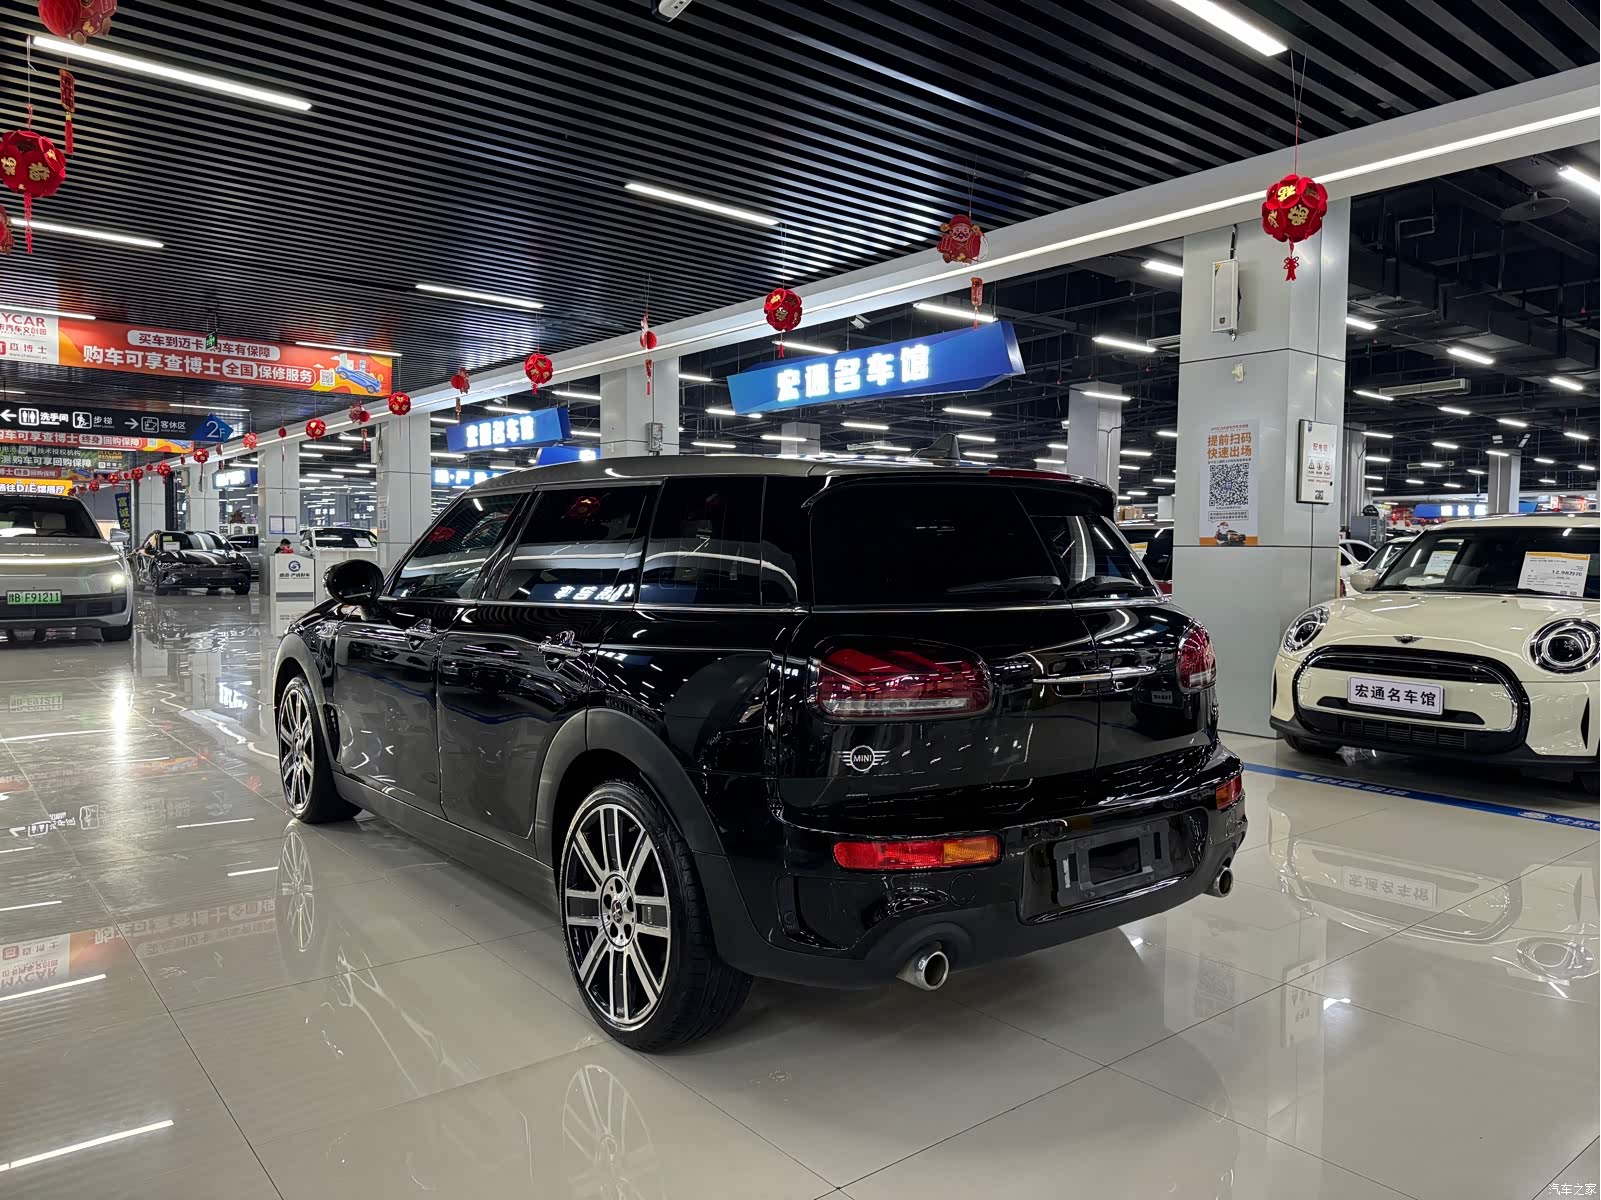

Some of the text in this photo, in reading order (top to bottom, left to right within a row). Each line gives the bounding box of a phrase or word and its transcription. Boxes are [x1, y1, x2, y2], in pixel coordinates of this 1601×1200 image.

[776, 344, 930, 402] 宏通名车馆
[40, 412, 69, 423] 洗手间
[93, 416, 113, 425] 步梯
[1207, 431, 1252, 447] 提前扫码
[1207, 444, 1252, 460] 快速出场
[1355, 684, 1436, 707] 宏通名车馆
[853, 754, 872, 763] MINI
